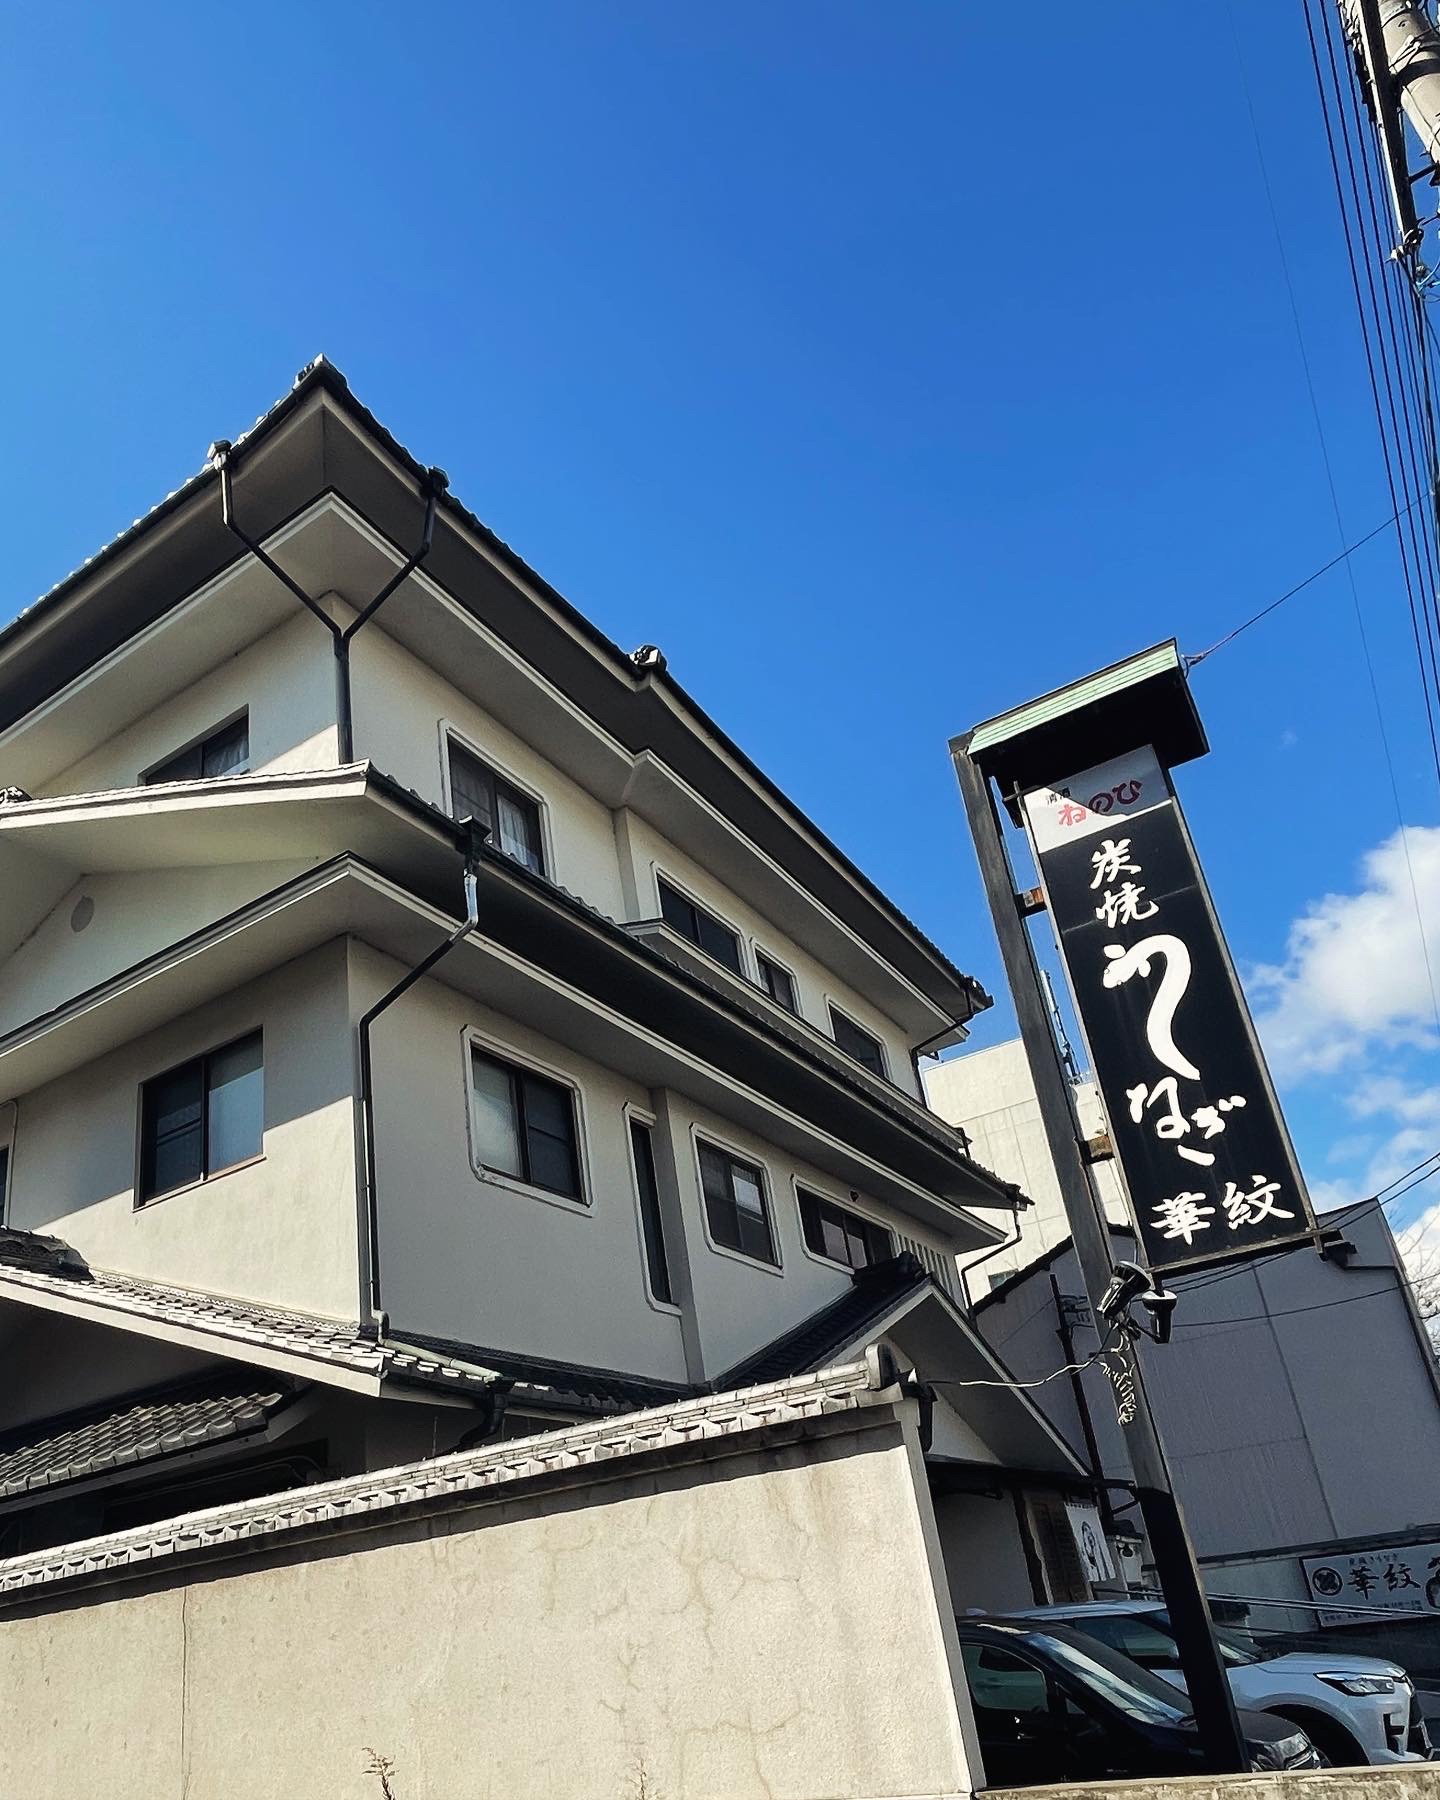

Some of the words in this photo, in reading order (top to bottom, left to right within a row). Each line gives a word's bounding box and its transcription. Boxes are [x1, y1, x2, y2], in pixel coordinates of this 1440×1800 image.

[1058, 780, 1142, 826] ねのひ
[1091, 838, 1159, 929] 炭焼
[1102, 934, 1246, 1166] うなぎ
[1151, 1174, 1295, 1245] 華紋
[1347, 1563, 1421, 1600] 華紋
